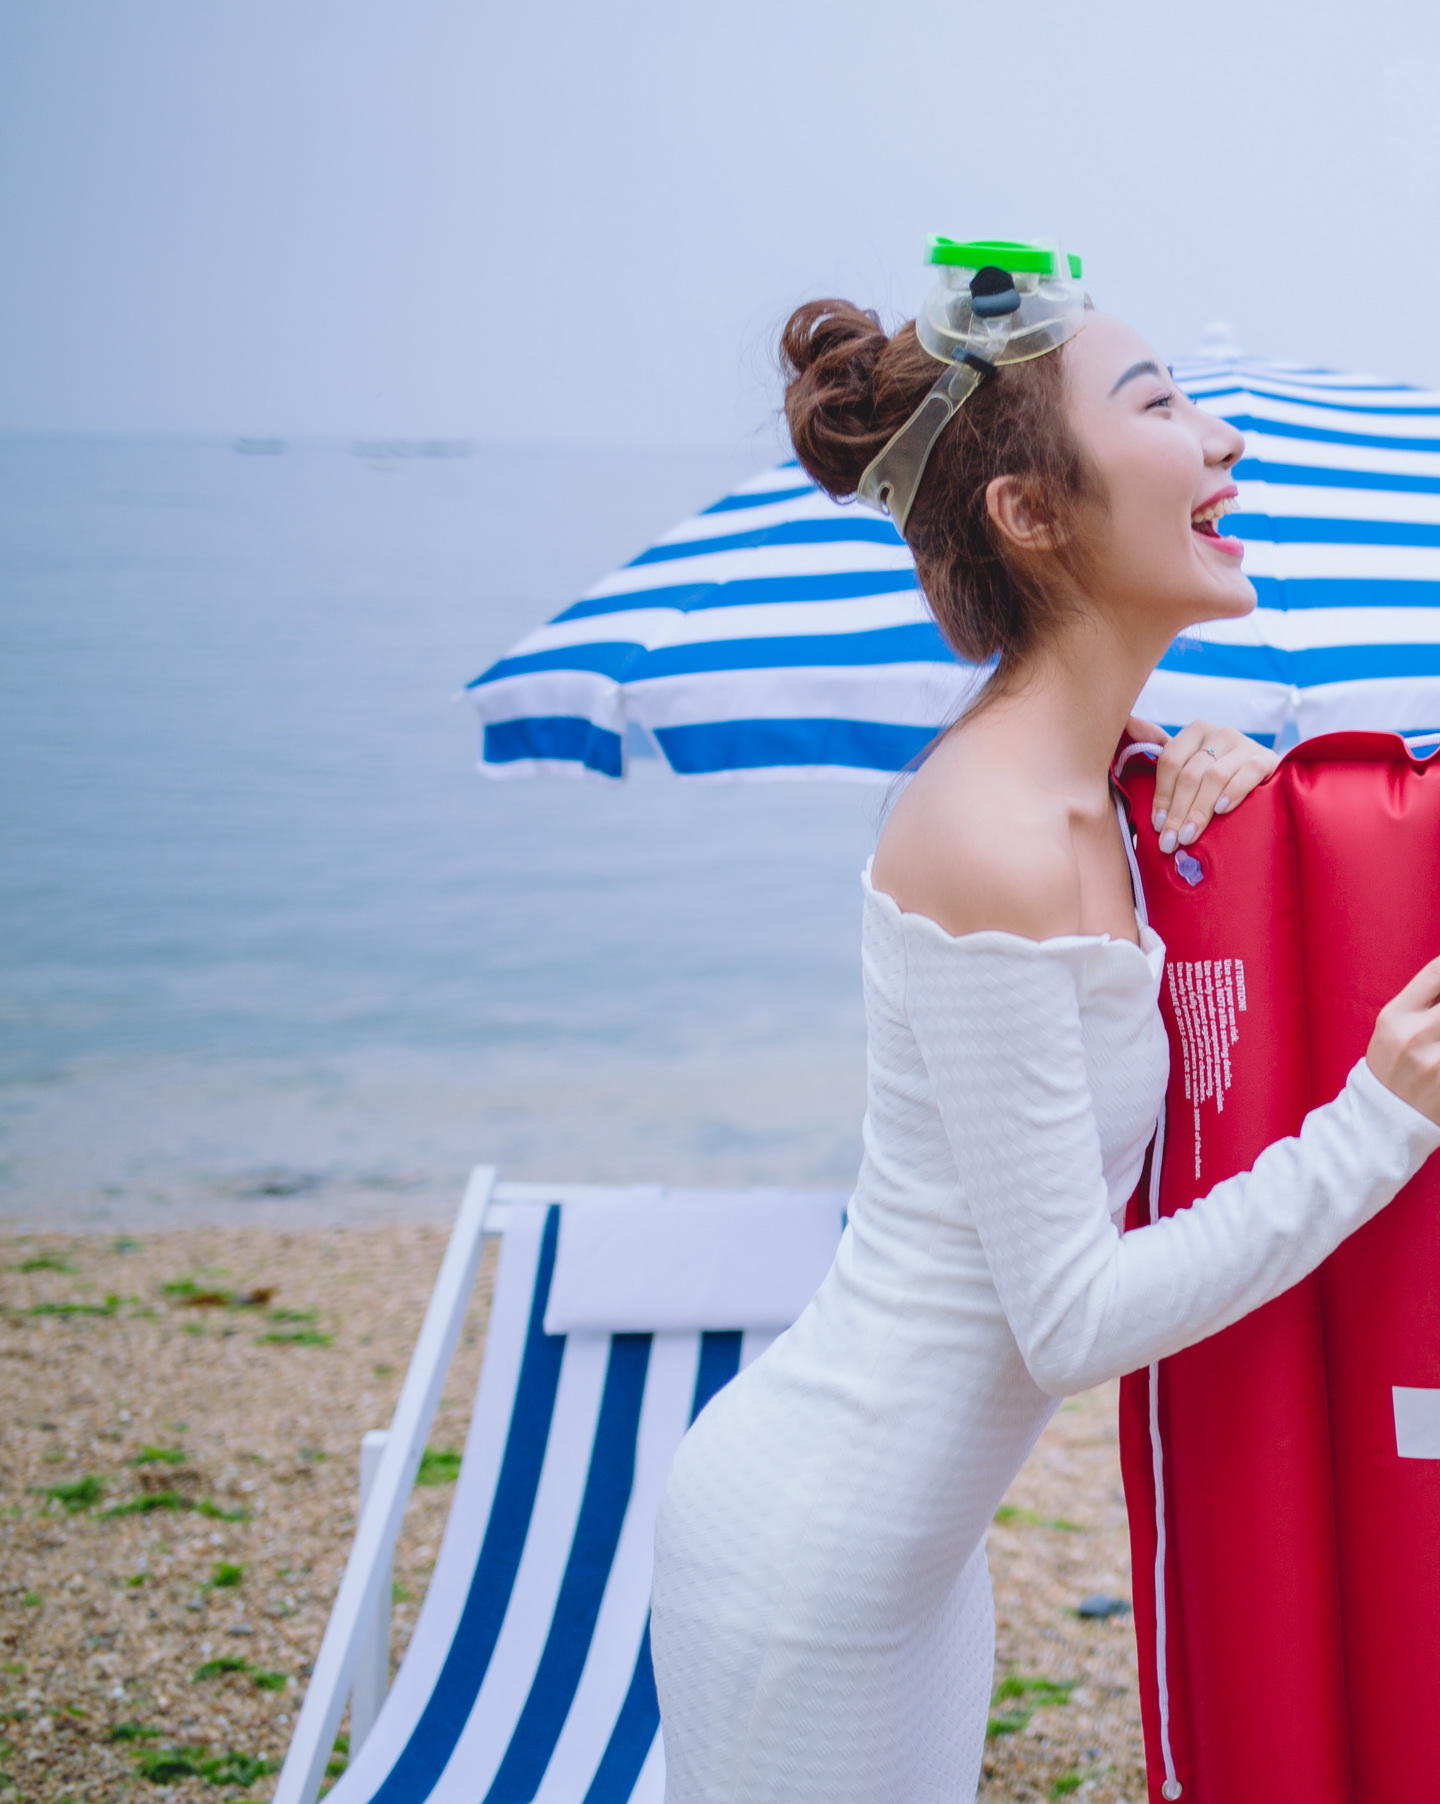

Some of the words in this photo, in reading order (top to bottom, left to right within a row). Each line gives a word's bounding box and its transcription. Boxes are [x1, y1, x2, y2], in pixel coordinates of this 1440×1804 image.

[1214, 960, 1223, 978] This
[1224, 959, 1232, 975] Use
[1178, 978, 1186, 994] only
[1204, 977, 1214, 994] only
[1215, 979, 1223, 987] is
[1225, 976, 1232, 985] at
[1235, 959, 1246, 1011] ATTENTION!
[1181, 996, 1187, 1004] in
[1216, 988, 1225, 1007] NOT
[1224, 986, 1233, 1006] your
[1207, 996, 1216, 1019] under
[1167, 963, 1179, 1006] SUPREME
[1184, 1059, 1190, 1072] OR
[1196, 995, 1208, 1024] protect
[1202, 1025, 1211, 1055] against
[1219, 1015, 1228, 1029] life
[1210, 1020, 1220, 1063] competent
[1220, 1030, 1230, 1058] saving
[1230, 1026, 1239, 1045] risk.
[1223, 1059, 1232, 1090] device.
[1214, 1064, 1224, 1114] supervision.
[1195, 1131, 1201, 1141] of
